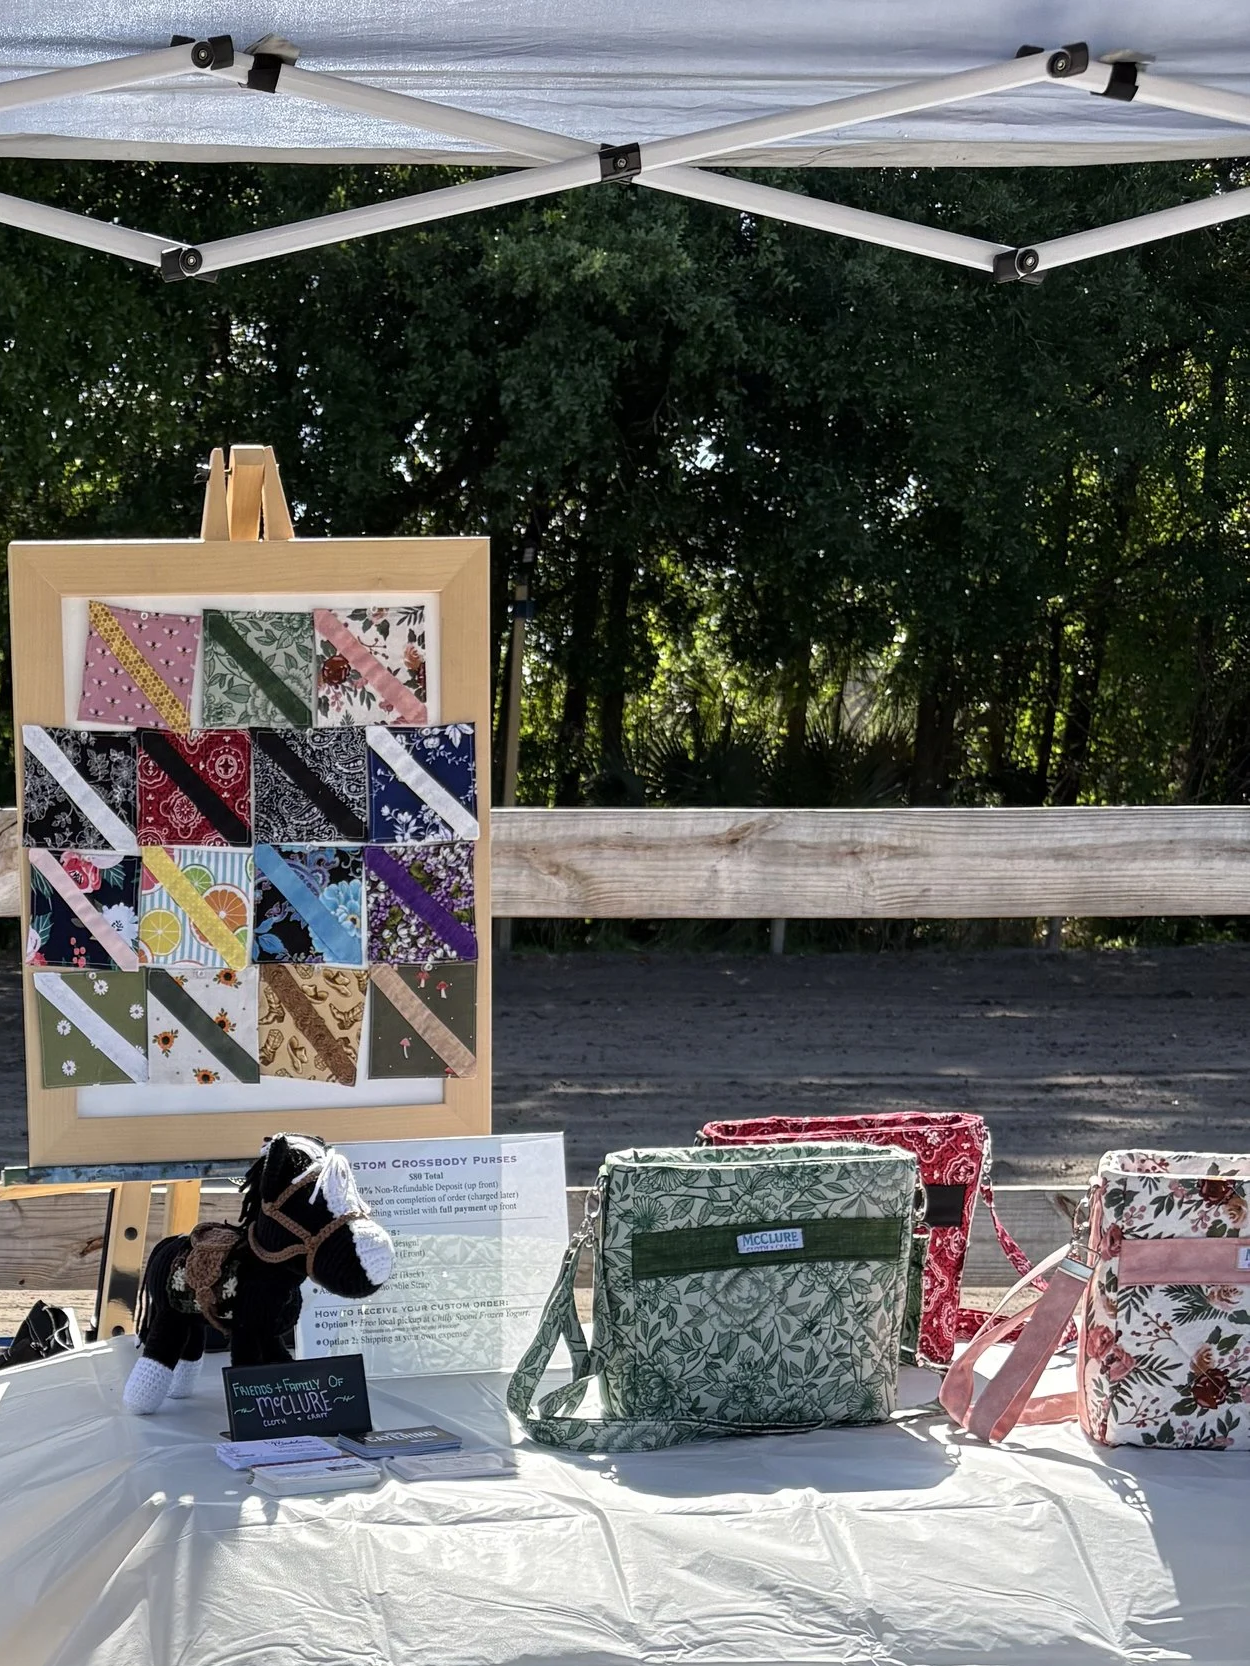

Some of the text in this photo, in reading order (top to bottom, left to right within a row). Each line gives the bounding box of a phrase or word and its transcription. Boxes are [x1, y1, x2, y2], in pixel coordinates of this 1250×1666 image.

[391, 1156, 468, 1169] CROSSBODY
[473, 1155, 518, 1165] PURSES
[424, 1171, 444, 1180] Total
[374, 1183, 434, 1194] Non-Refundable
[435, 1183, 463, 1193] Deposit
[464, 1182, 477, 1192] (up
[478, 1180, 499, 1190] front)
[395, 1195, 437, 1206] completion
[437, 1193, 447, 1202] of
[447, 1192, 466, 1202] order
[468, 1191, 499, 1202] (charged
[499, 1190, 519, 1200] later)
[393, 1207, 420, 1217] wristlet
[421, 1206, 438, 1214] with
[439, 1205, 453, 1214] full
[454, 1204, 487, 1215] payment
[488, 1204, 498, 1213] up
[499, 1202, 517, 1210] front
[314, 1309, 338, 1319] HOW
[357, 1306, 398, 1316] RECEIVE
[401, 1304, 429, 1313] YOUR
[430, 1302, 470, 1312] CUSTOM
[473, 1299, 509, 1309] ORDER:
[321, 1320, 348, 1331] Option
[359, 1318, 377, 1327] Free
[377, 1317, 396, 1326] local
[322, 1338, 349, 1348] Option
[360, 1334, 393, 1345] Shipping
[262, 1418, 287, 1428] CLOTH
[306, 1411, 328, 1421] CRAFT
